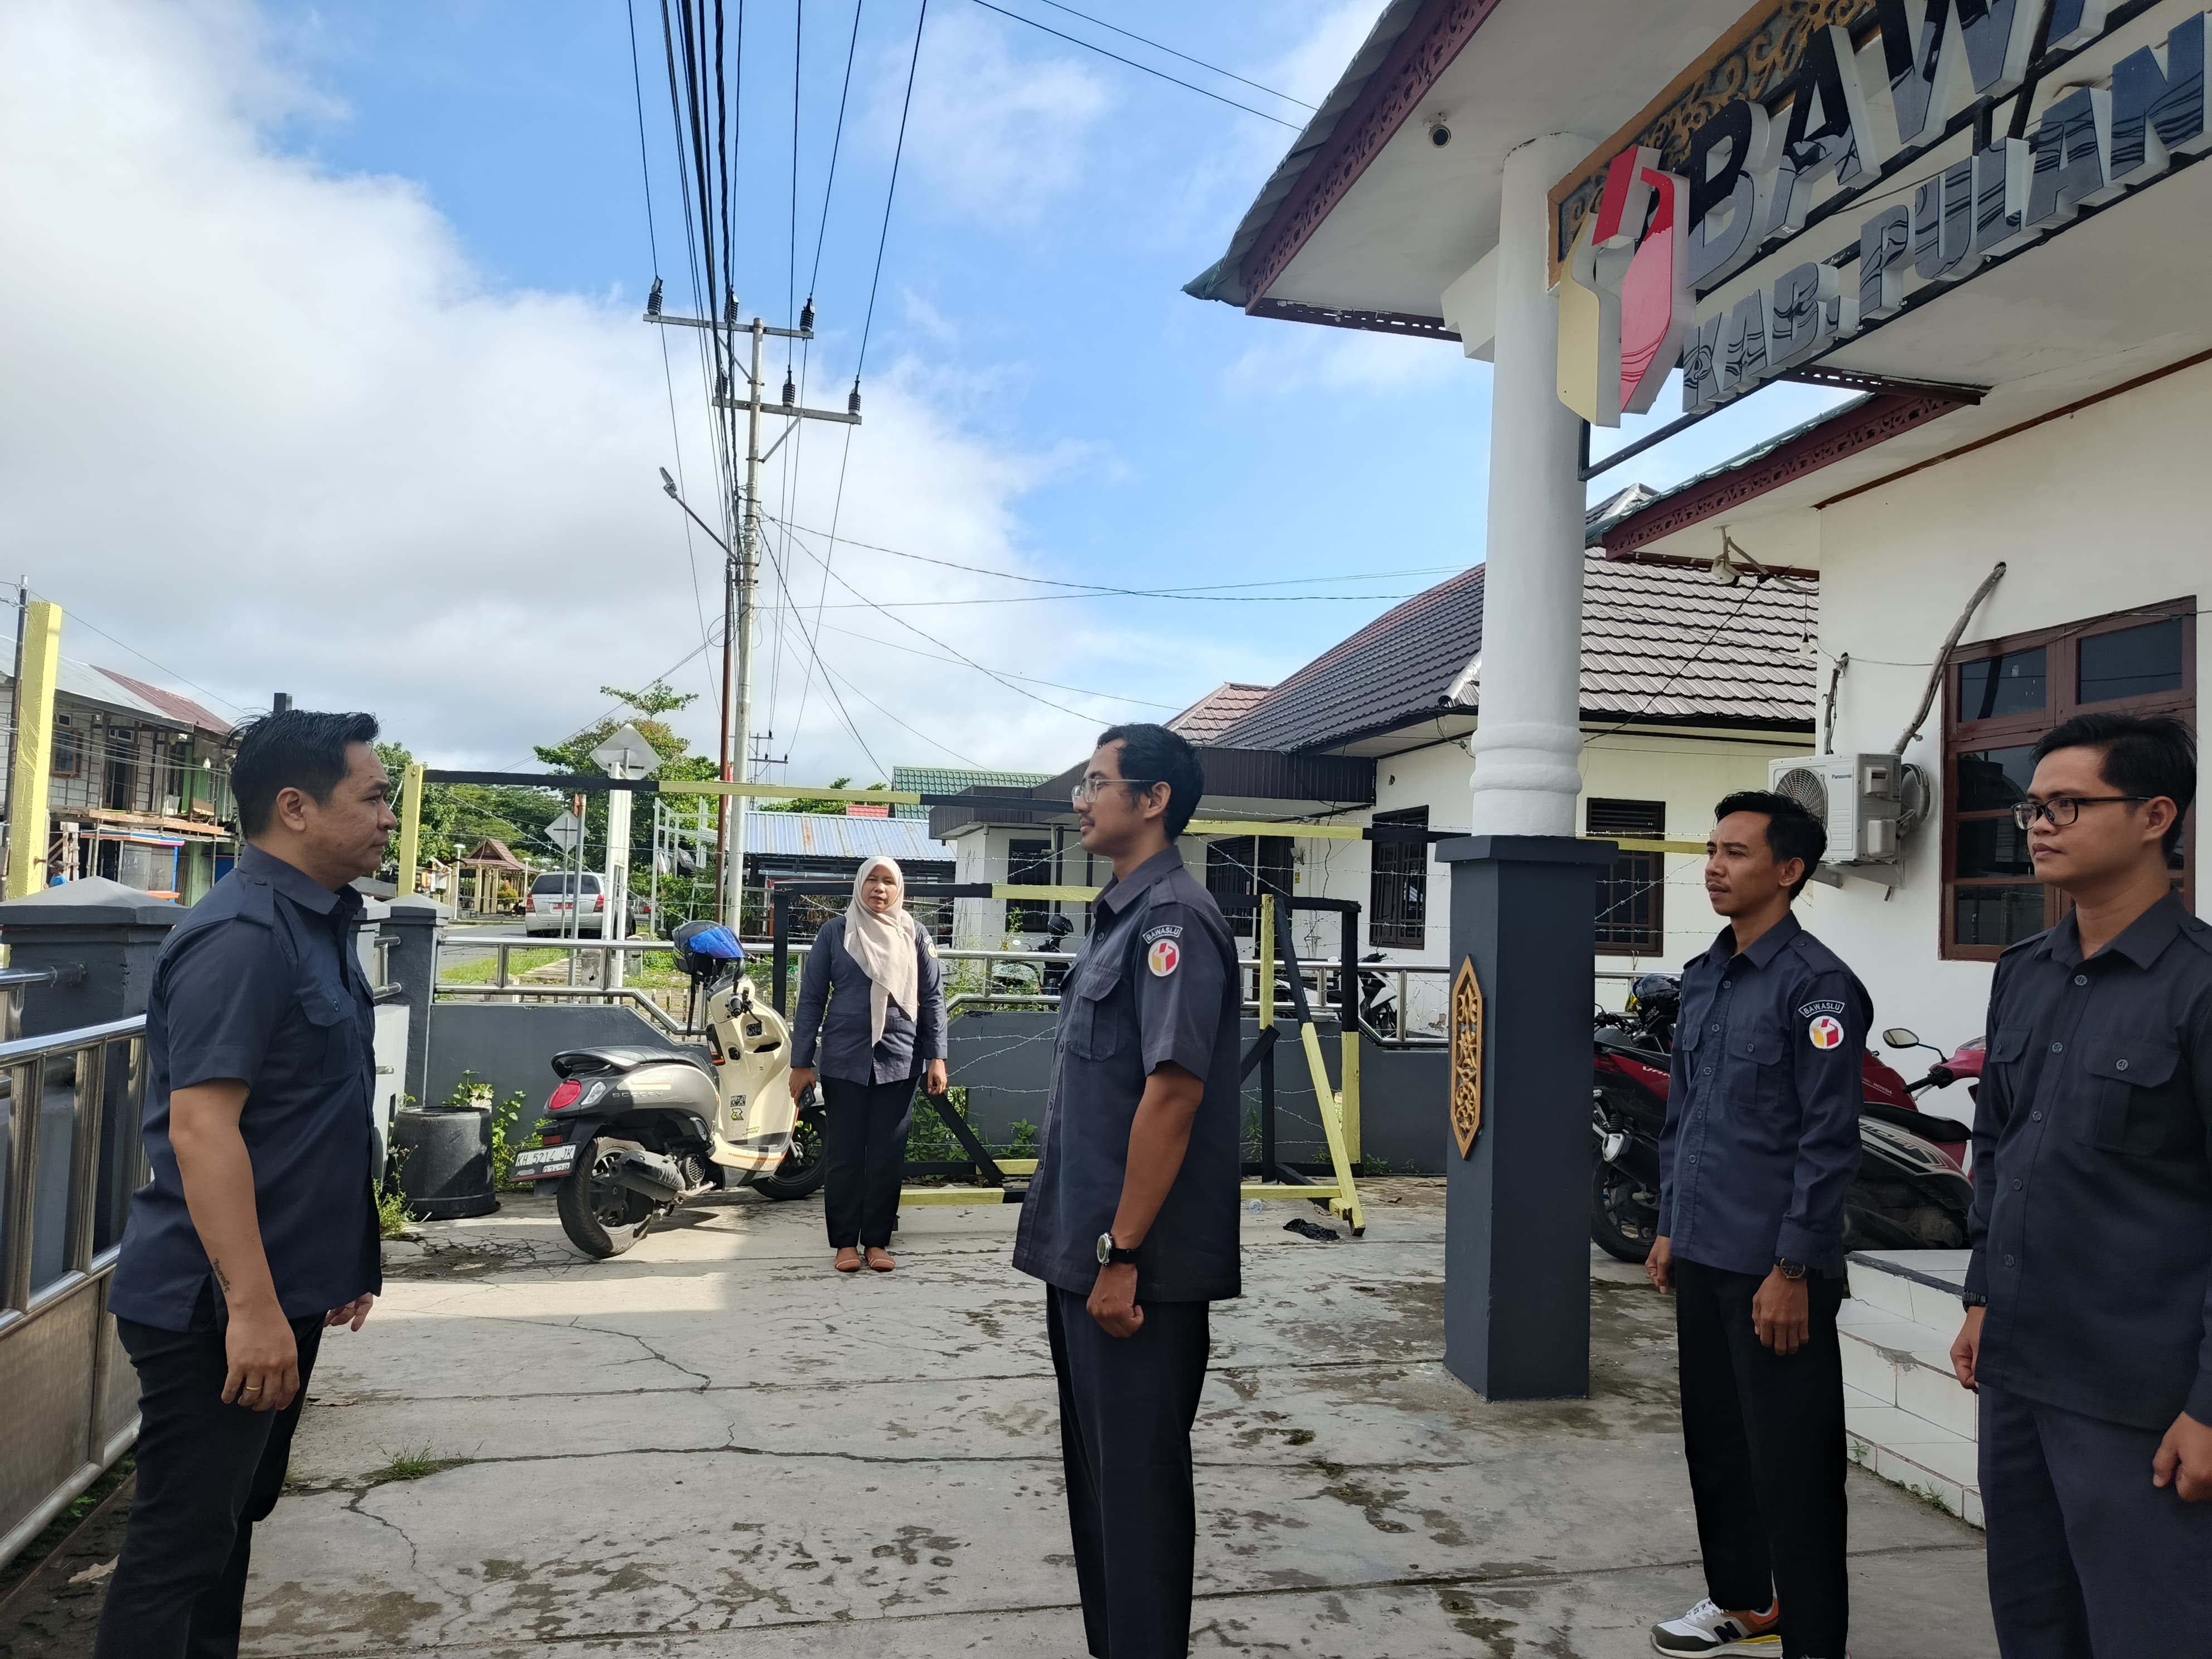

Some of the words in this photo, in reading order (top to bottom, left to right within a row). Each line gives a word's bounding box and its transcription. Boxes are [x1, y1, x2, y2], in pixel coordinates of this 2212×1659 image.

[1689, 0, 2089, 290] BAW
[1682, 262, 1850, 413] KAB.
[1146, 927, 1180, 940] BAWASLU
[1803, 1003, 1840, 1014] BAWASLU
[1873, 1082, 1893, 1095] HONDA
[516, 1154, 528, 1167] KH
[533, 1150, 556, 1164] 5214
[560, 1147, 574, 1160] JK
